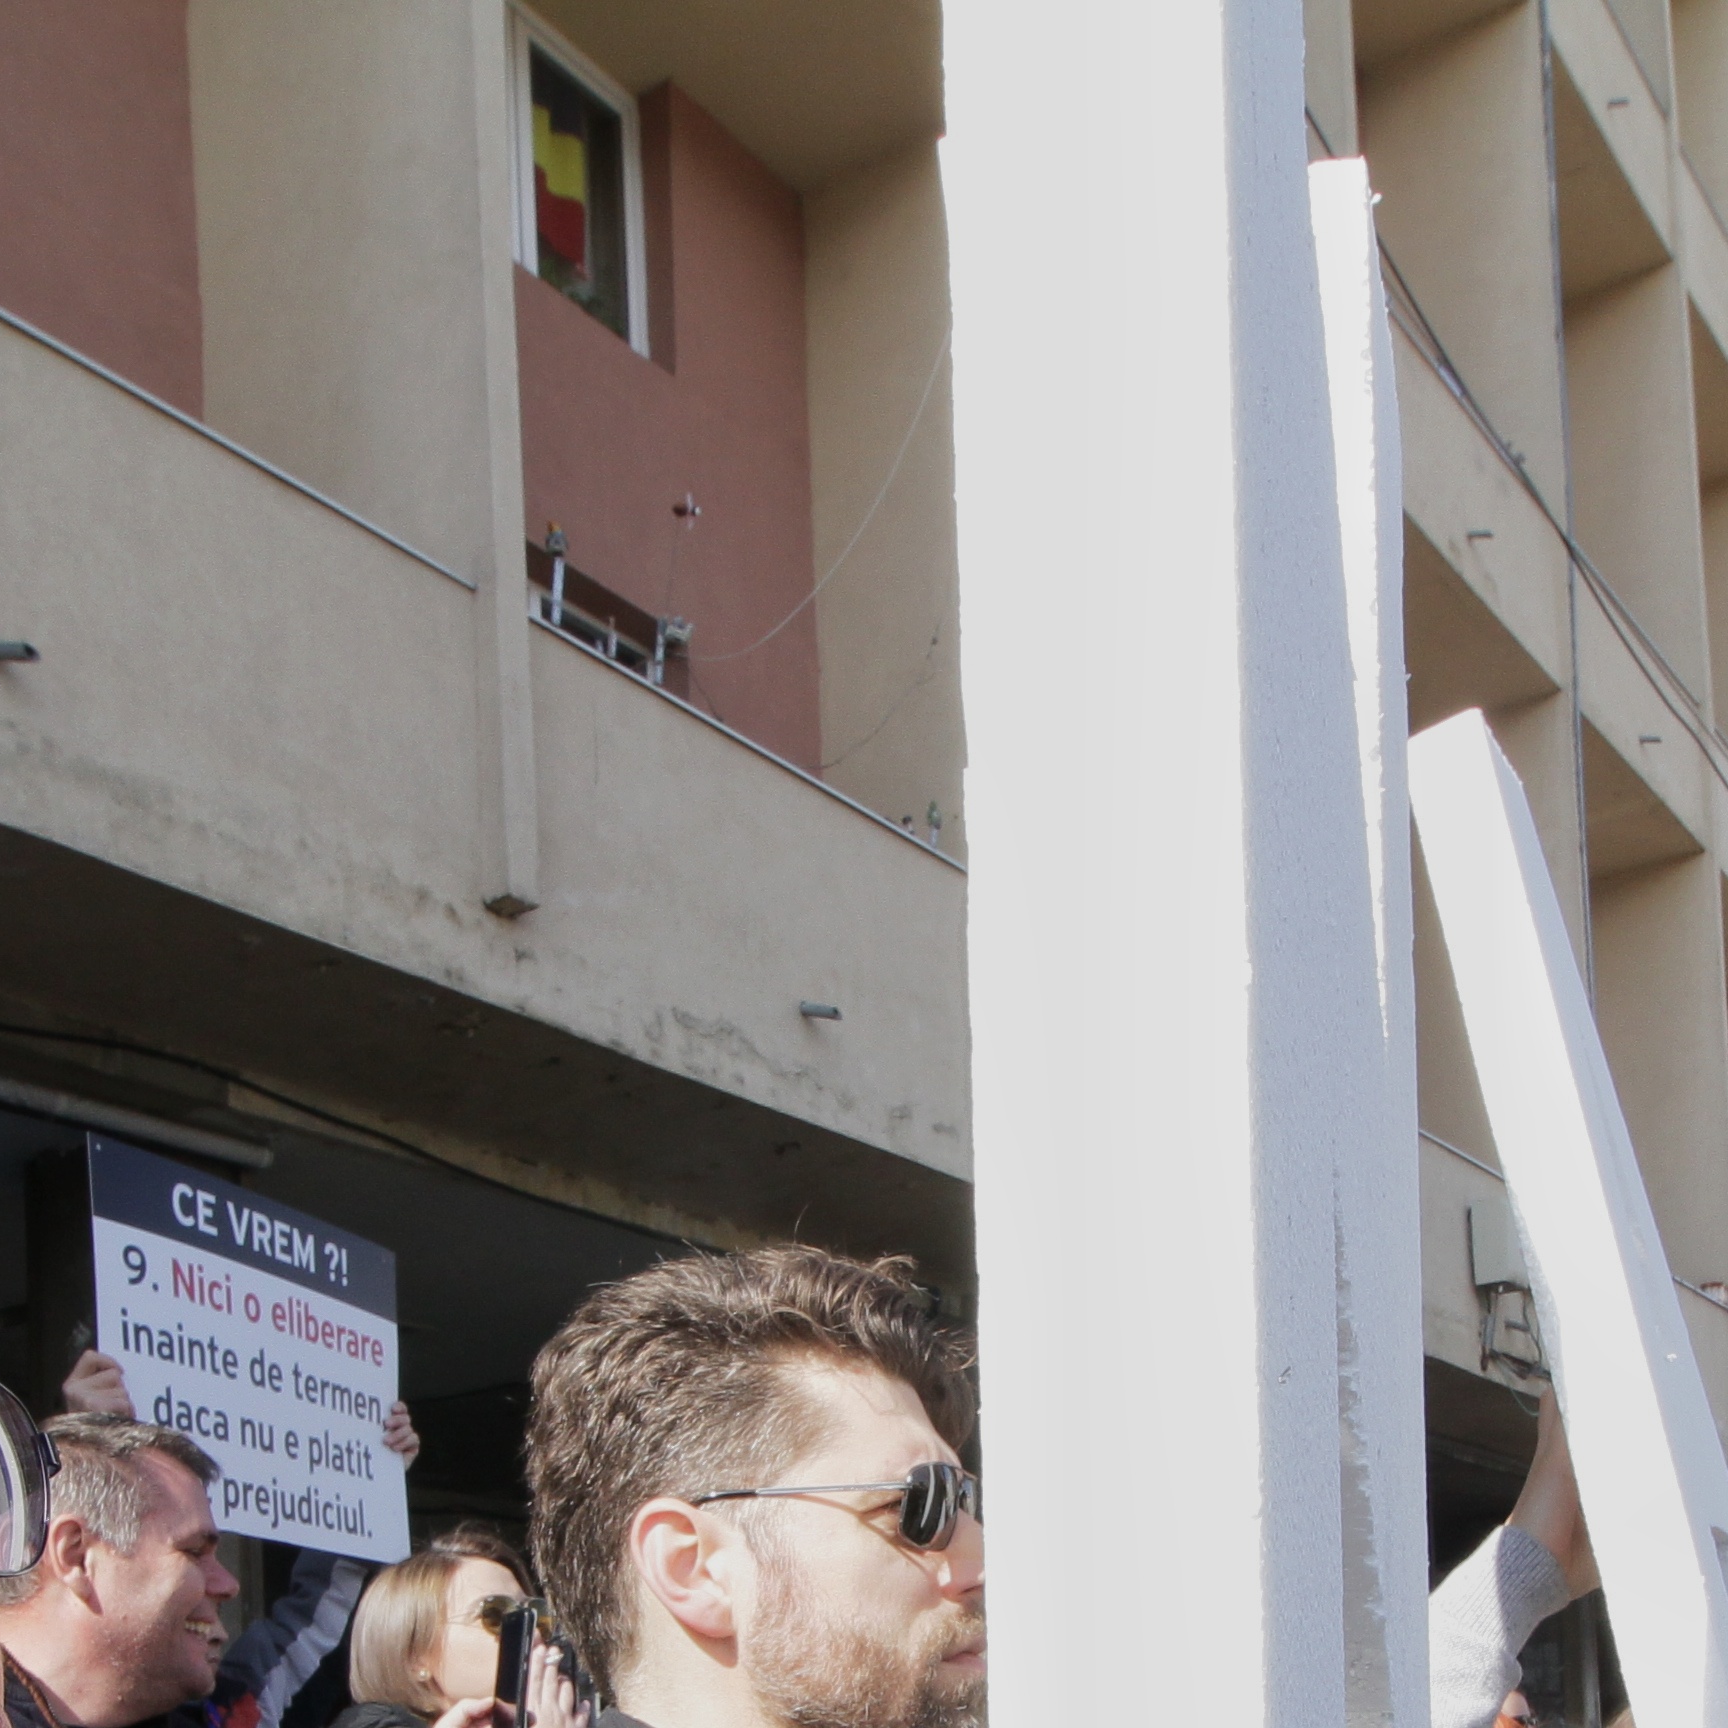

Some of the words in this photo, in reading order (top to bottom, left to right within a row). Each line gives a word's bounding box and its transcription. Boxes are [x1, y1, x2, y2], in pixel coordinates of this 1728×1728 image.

[172, 1182, 218, 1236] CE
[227, 1201, 315, 1273] VREM
[323, 1243, 349, 1286] ?!
[121, 1309, 238, 1379] inainte
[249, 1350, 283, 1393] de
[122, 1245, 159, 1292] 9.
[172, 1258, 233, 1315] Nici
[243, 1295, 261, 1323] o
[271, 1298, 384, 1367] eliberare
[153, 1386, 229, 1441] daca
[240, 1415, 275, 1453] nu
[284, 1433, 300, 1458] e
[308, 1431, 374, 1481] platit
[223, 1477, 373, 1538] prejudiciul.
